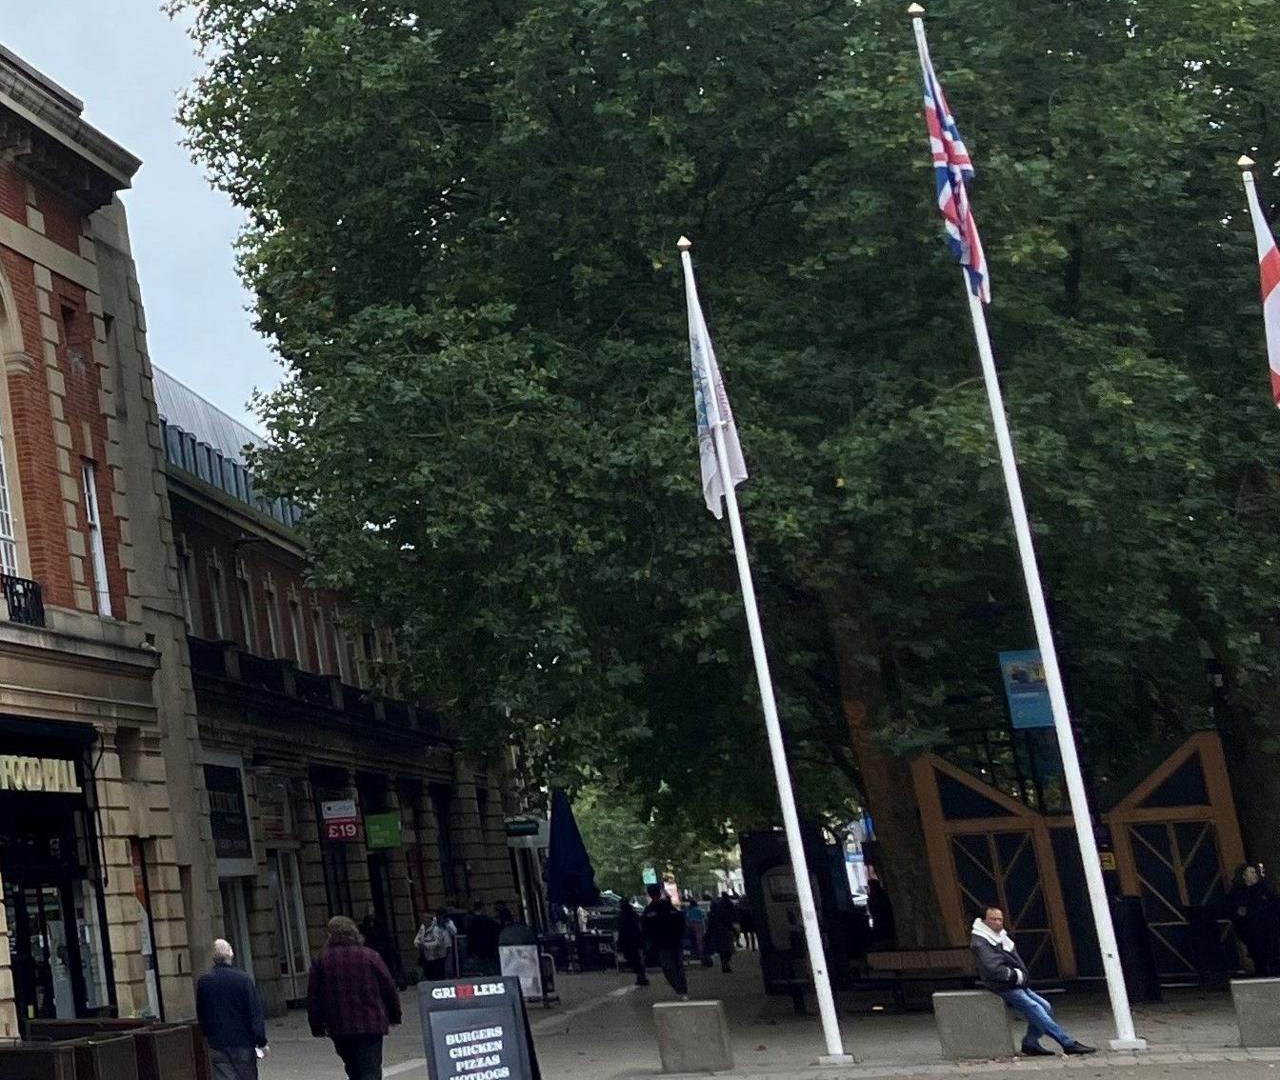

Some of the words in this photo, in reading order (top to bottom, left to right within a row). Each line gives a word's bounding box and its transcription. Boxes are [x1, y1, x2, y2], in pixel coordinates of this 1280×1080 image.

[328, 823, 357, 838] £19
[445, 1026, 503, 1045] BURGERS
[449, 1040, 503, 1059] CHICKEN
[455, 1054, 501, 1072] PIZZAS
